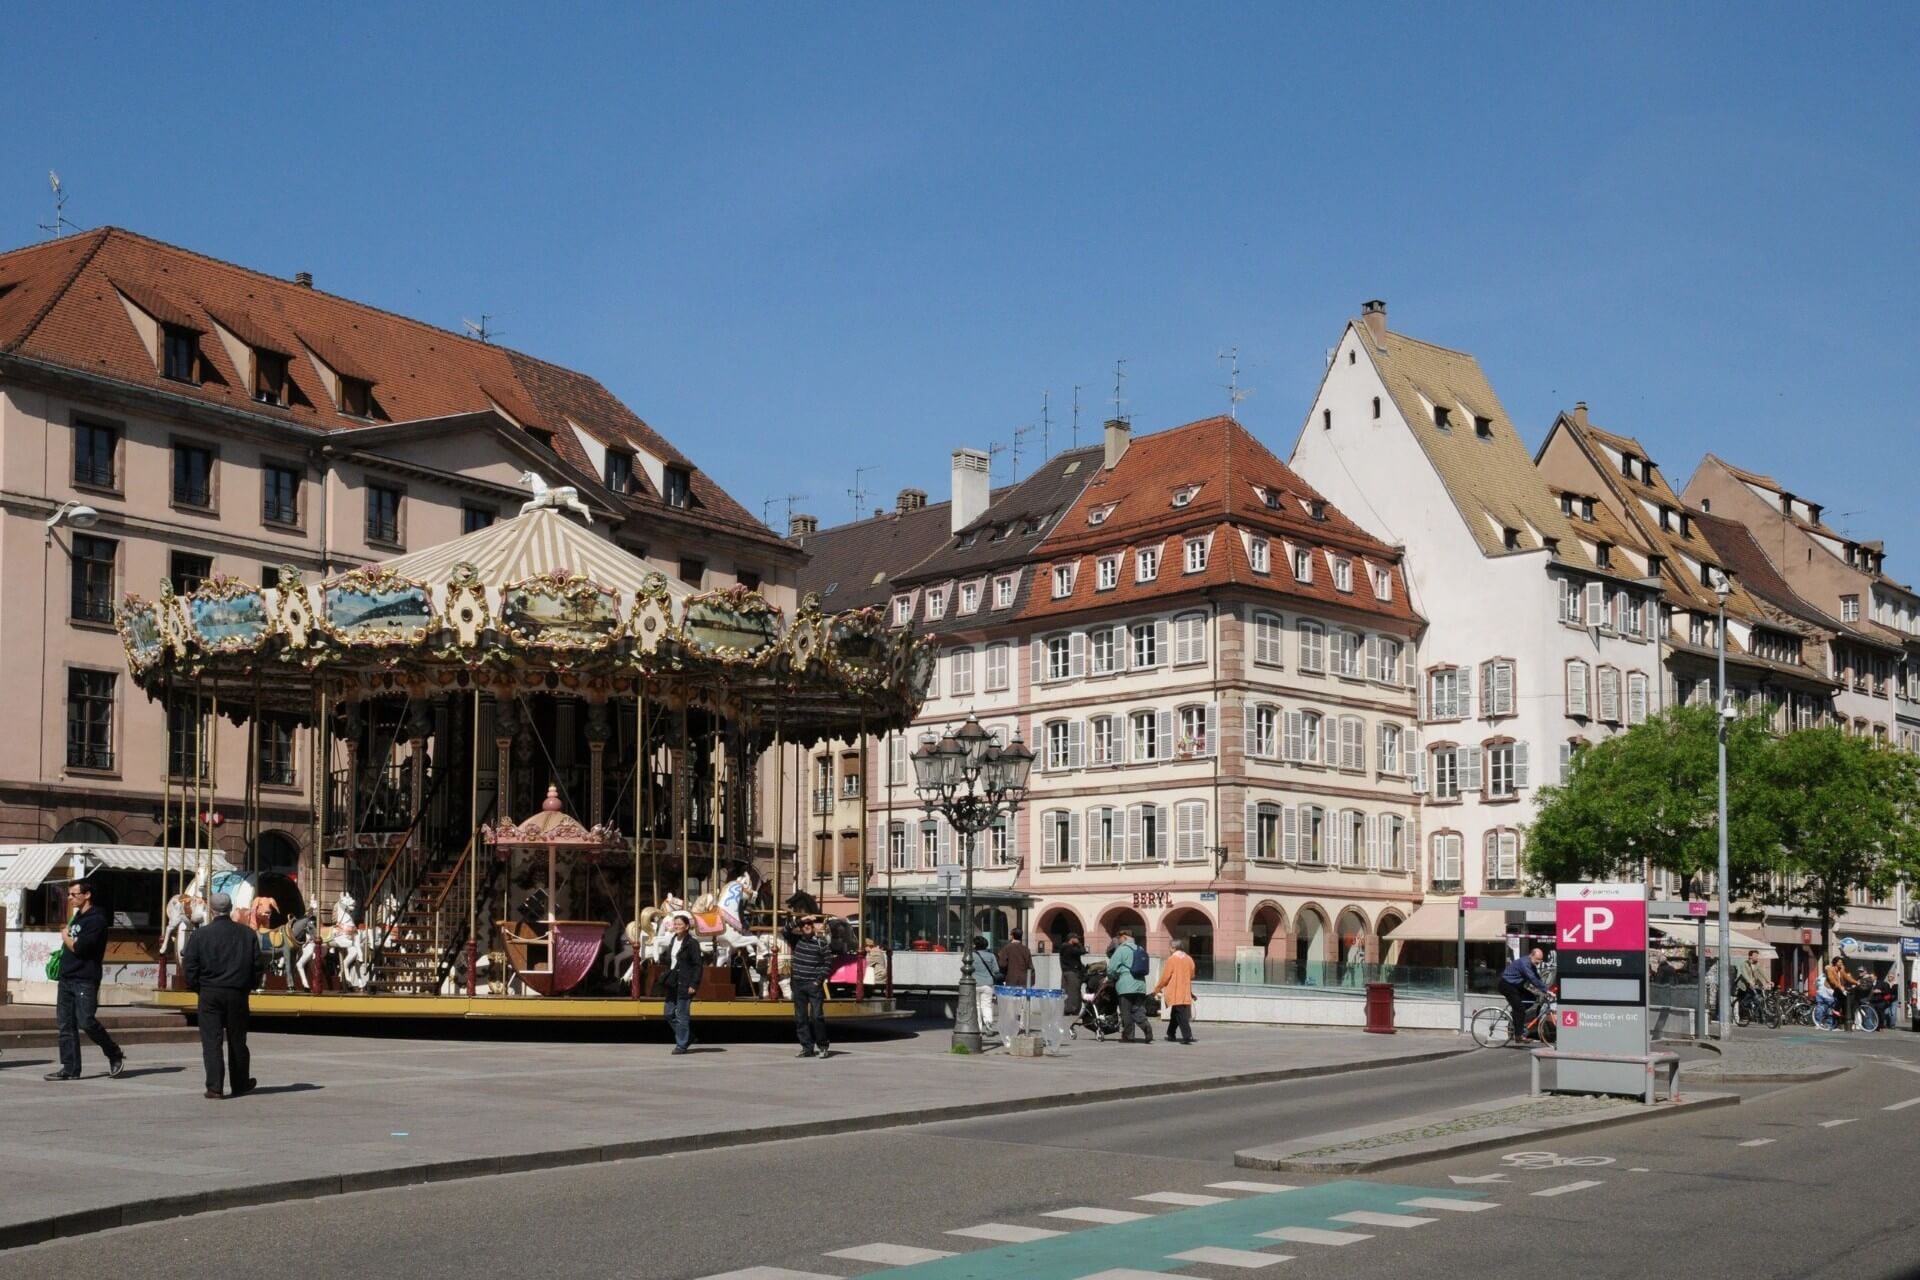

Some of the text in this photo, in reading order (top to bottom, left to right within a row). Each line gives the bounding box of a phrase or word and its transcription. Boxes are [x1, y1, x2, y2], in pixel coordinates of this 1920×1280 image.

[1133, 892, 1172, 905] BERYL
[1584, 907, 1614, 943] P
[1576, 956, 1622, 967] Gutenberg
[1579, 1012, 1601, 1020] Places
